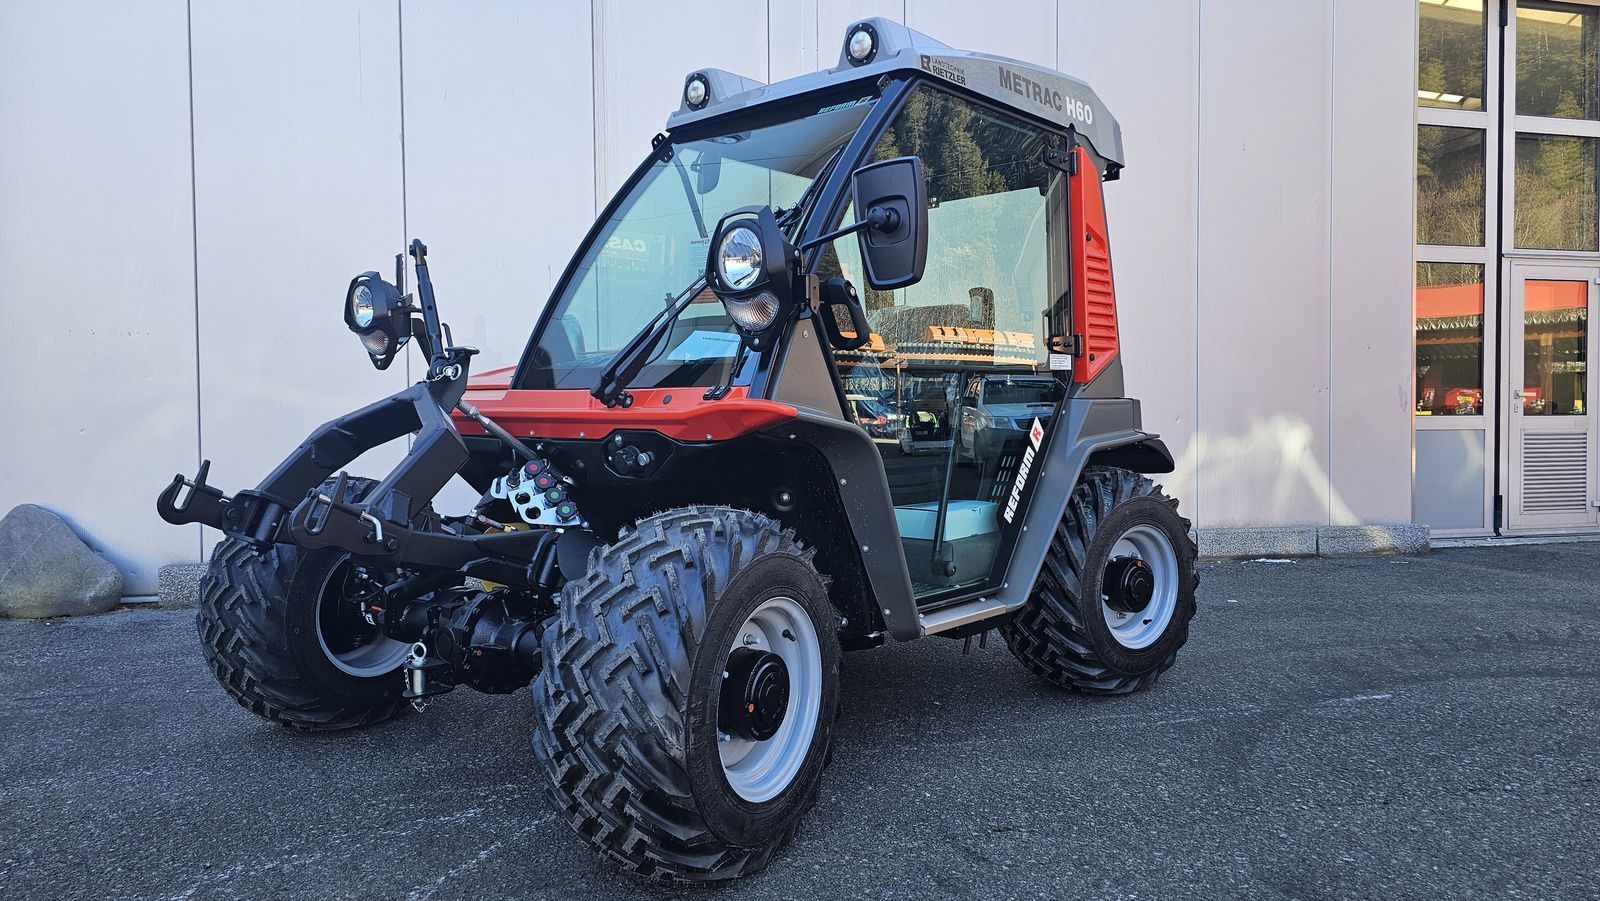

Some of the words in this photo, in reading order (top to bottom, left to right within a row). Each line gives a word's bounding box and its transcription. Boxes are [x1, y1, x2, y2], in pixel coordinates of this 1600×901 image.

[933, 65, 966, 85] RIETZLER
[999, 66, 1062, 111] METRAC
[1066, 96, 1093, 124] H60
[1003, 445, 1035, 524] REFORM
